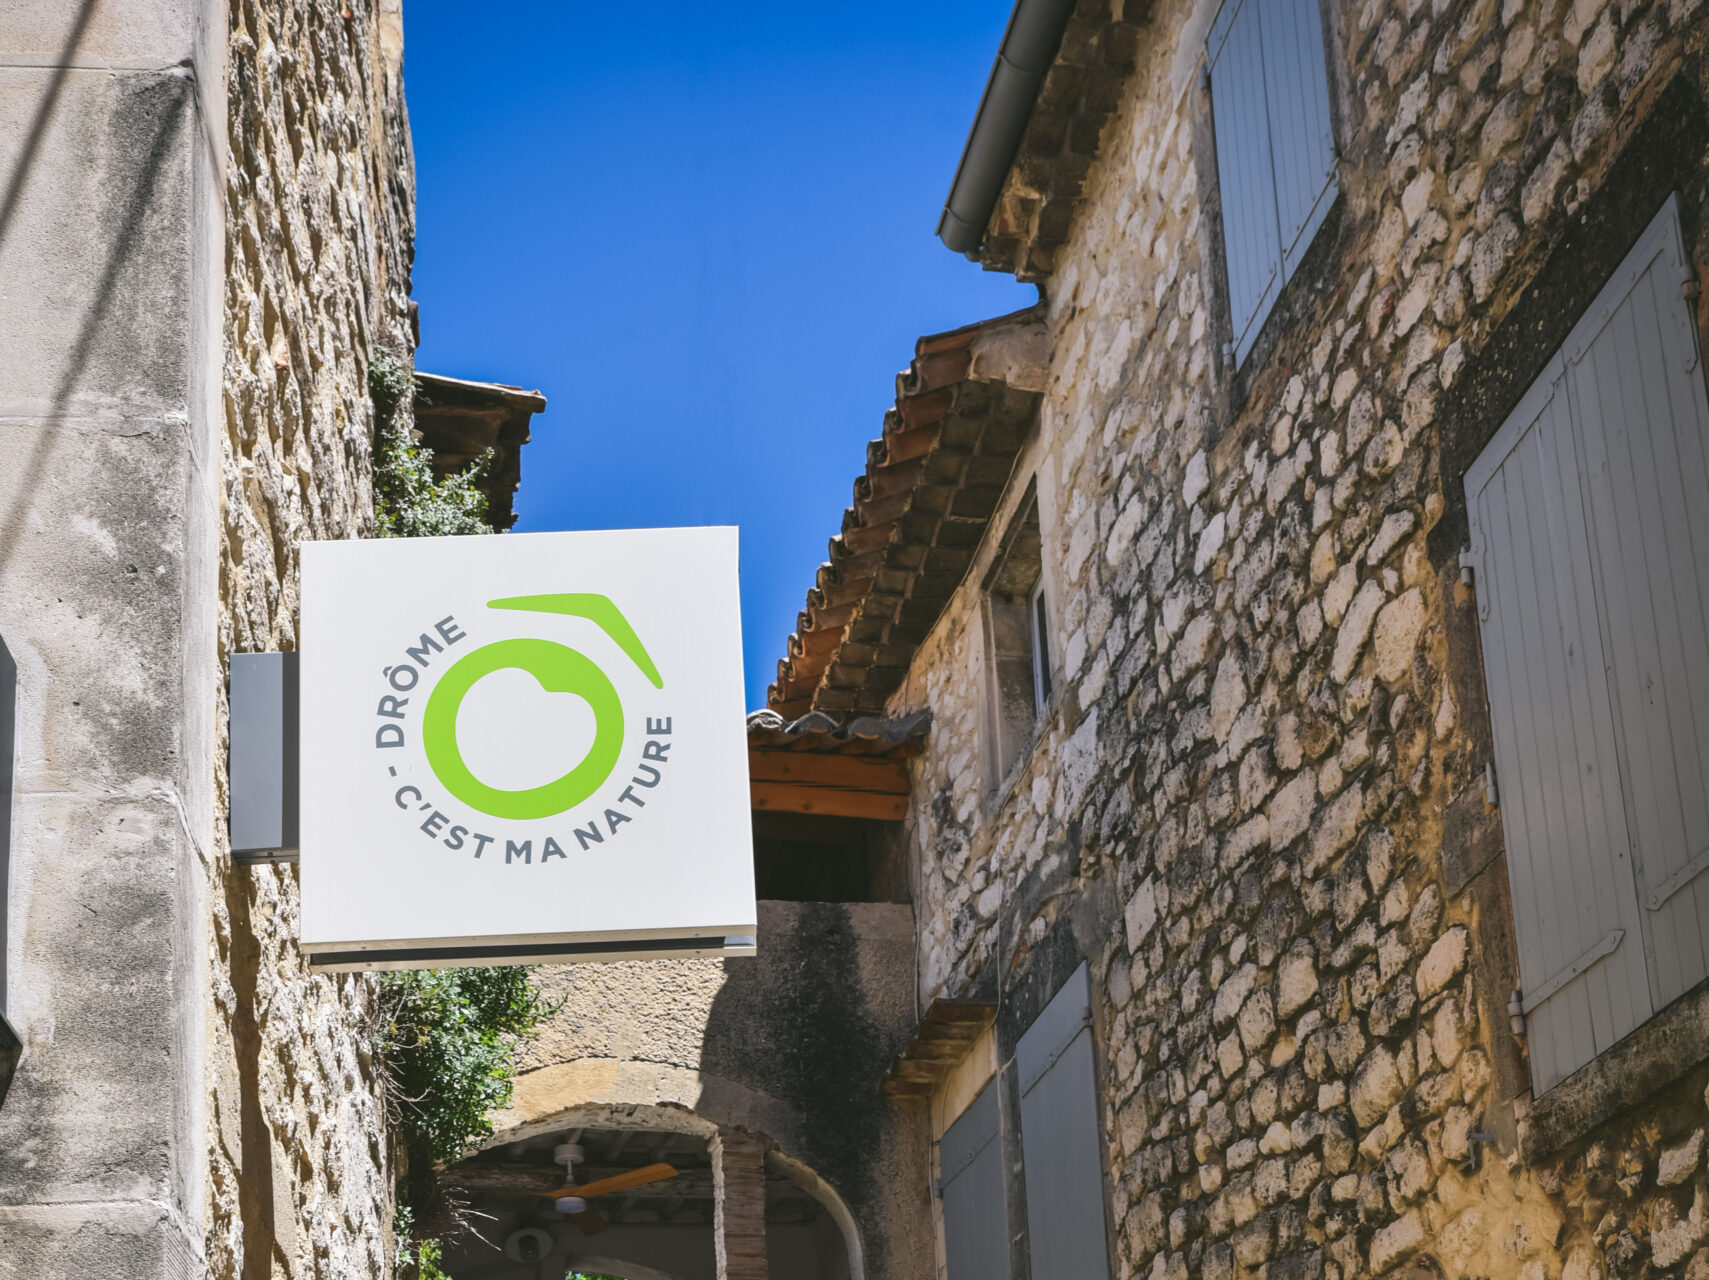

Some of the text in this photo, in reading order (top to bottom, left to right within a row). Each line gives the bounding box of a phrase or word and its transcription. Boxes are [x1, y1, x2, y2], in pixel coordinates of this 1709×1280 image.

[375, 615, 467, 749] DRÔME
[394, 784, 495, 859] C'EST
[572, 716, 672, 851] NATURE
[505, 836, 568, 864] MA
